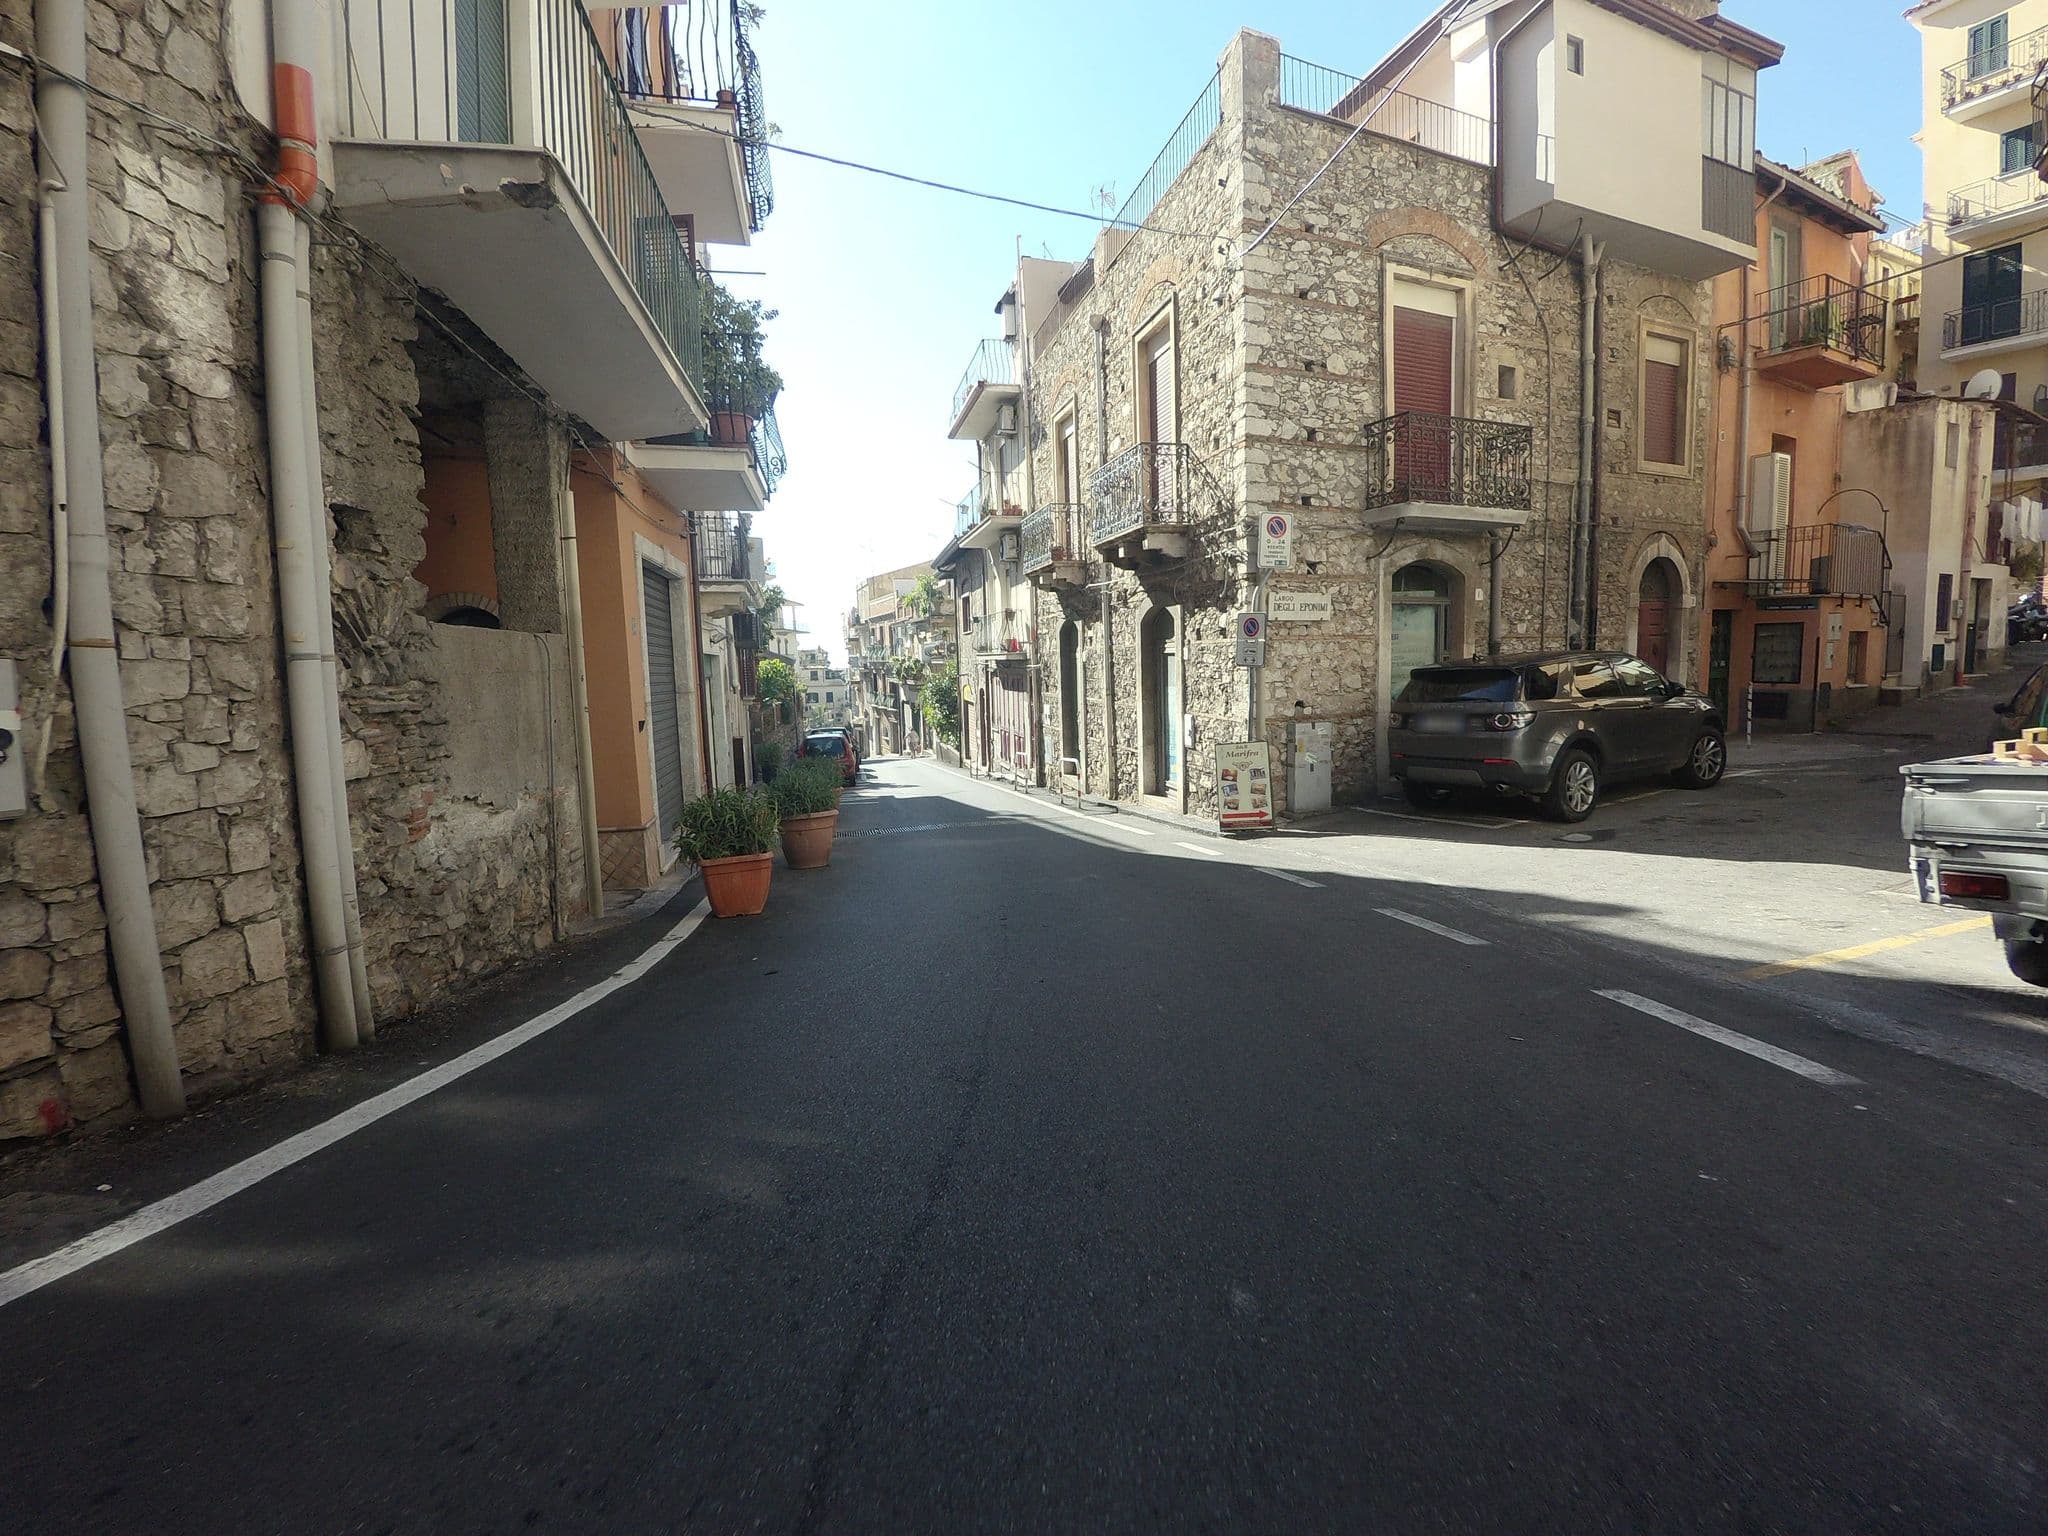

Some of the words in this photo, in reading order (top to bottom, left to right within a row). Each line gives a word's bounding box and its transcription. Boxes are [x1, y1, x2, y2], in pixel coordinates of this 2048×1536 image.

[1273, 602, 1295, 611] DEGLI
[1299, 602, 1328, 611] EPONIMI
[1226, 750, 1258, 759] Marifra
